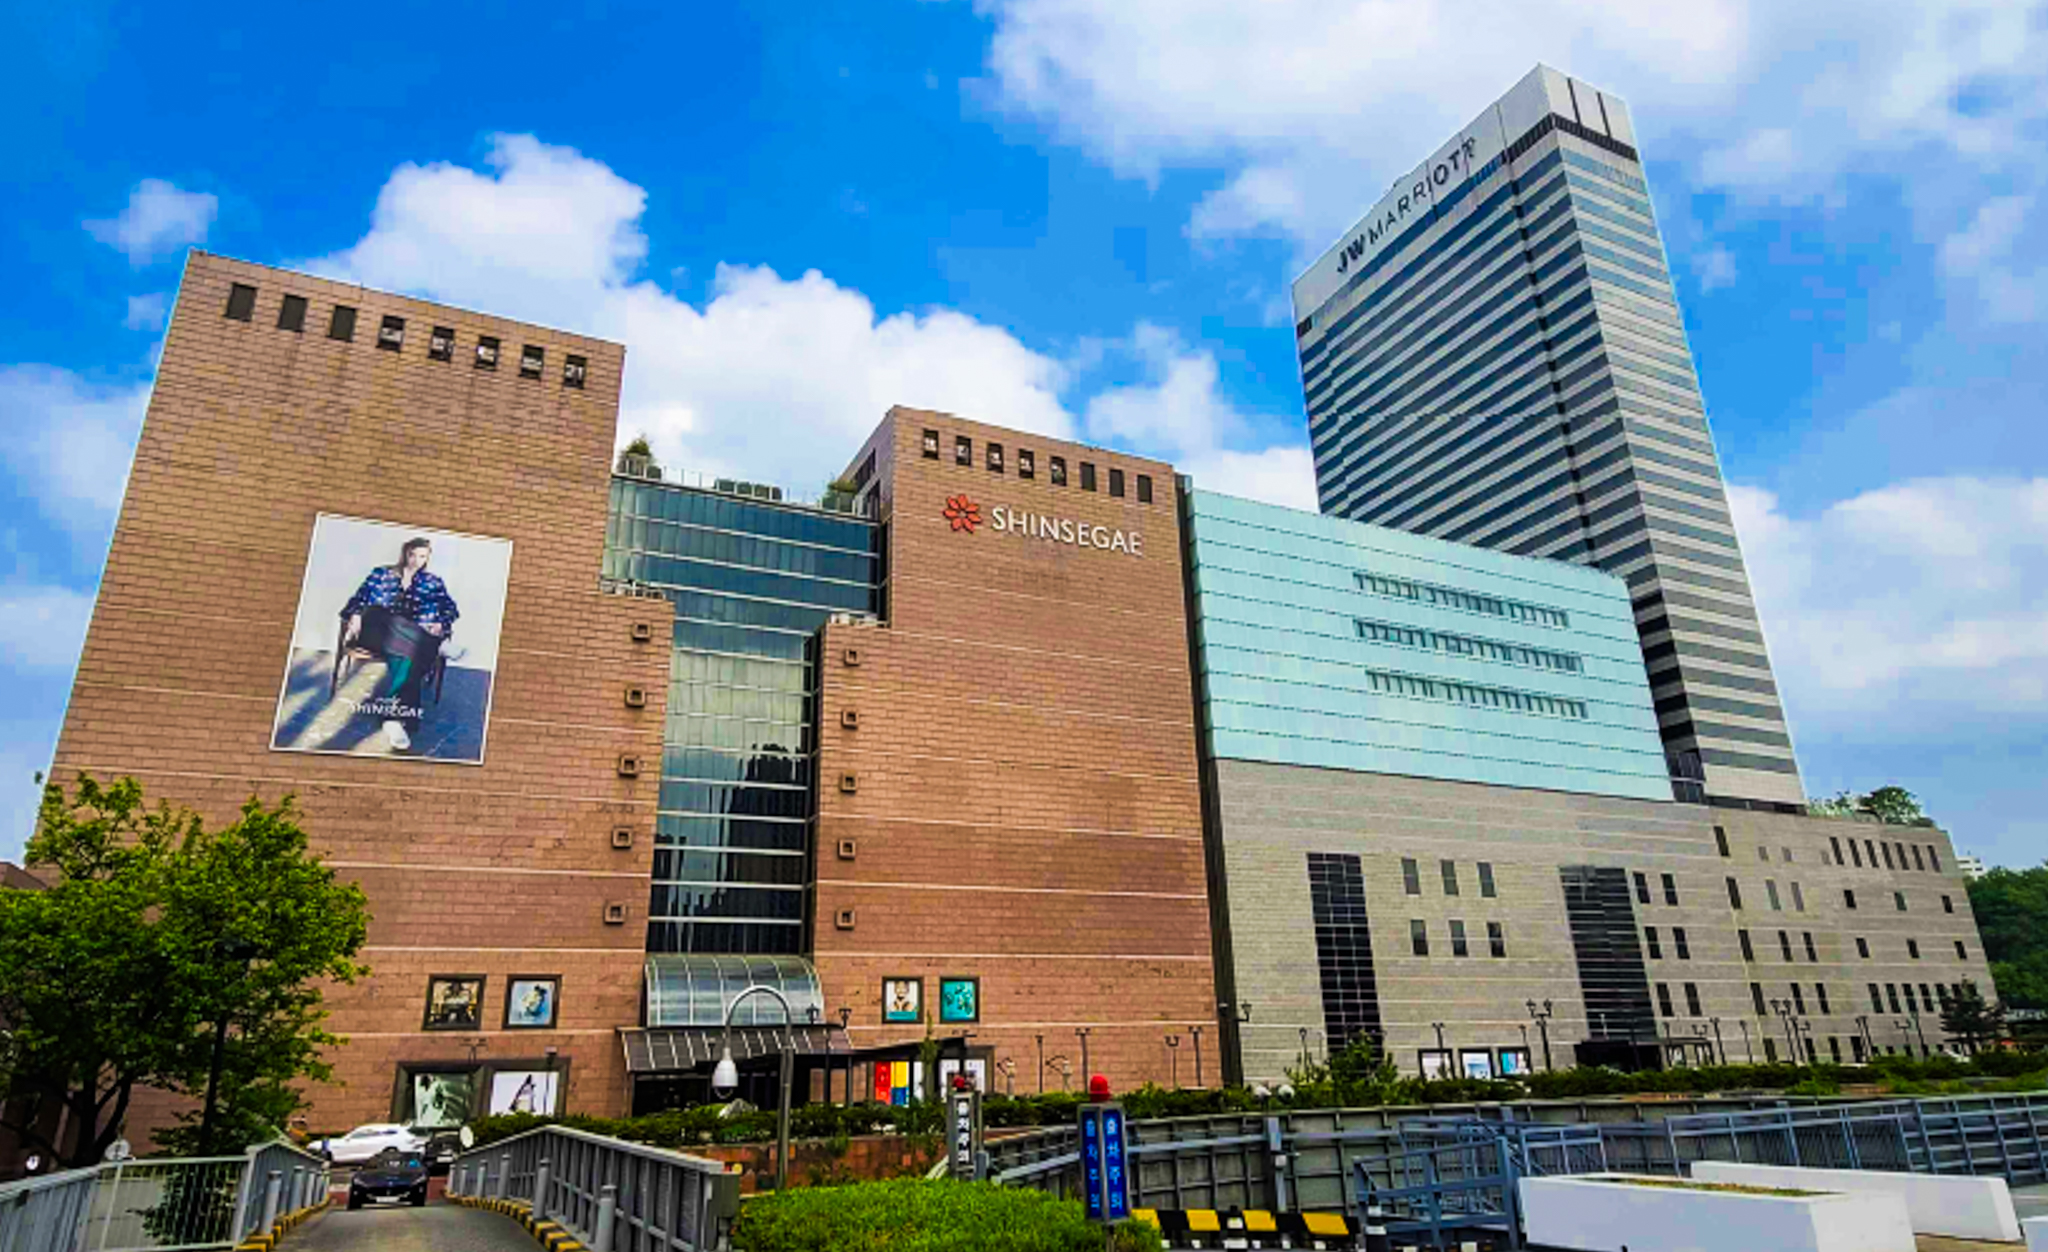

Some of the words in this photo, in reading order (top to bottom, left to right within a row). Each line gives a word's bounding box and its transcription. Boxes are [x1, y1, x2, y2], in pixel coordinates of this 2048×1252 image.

[1337, 234, 1366, 273] JW
[1369, 136, 1476, 246] MARRIOTT
[992, 508, 1143, 556] SHINSEGAE
[1106, 1116, 1123, 1211] 출차주의
